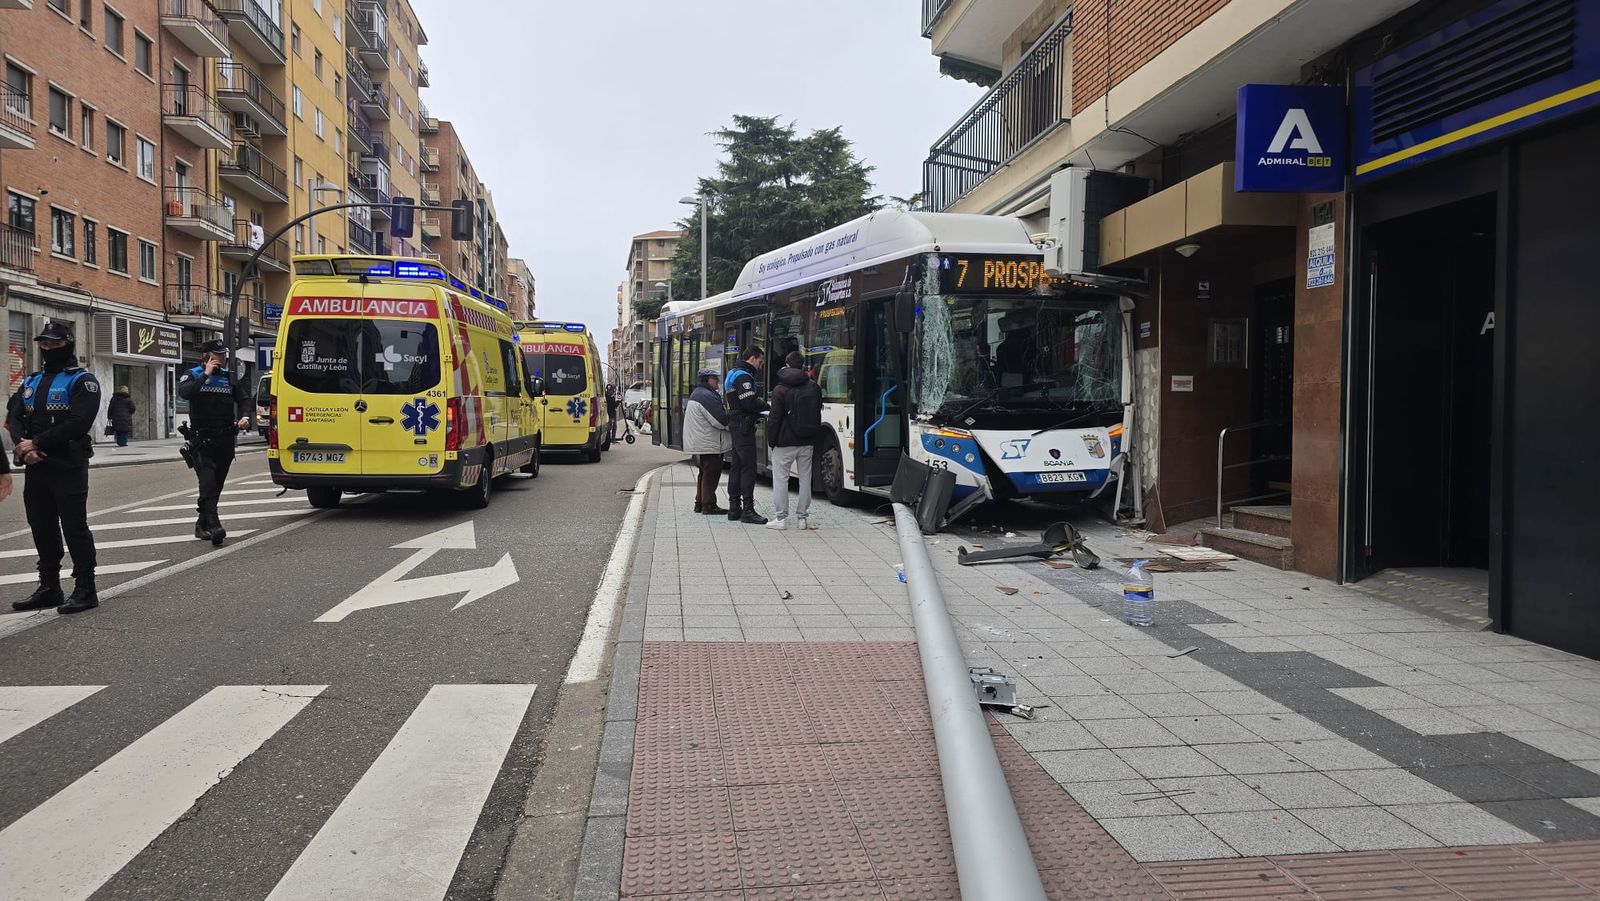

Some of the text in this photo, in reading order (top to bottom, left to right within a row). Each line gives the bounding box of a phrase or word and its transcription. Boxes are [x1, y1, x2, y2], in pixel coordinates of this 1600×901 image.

[1267, 108, 1323, 153] A
[1258, 157, 1331, 167] ADMIRAL BET
[788, 247, 813, 264] Propulsado
[814, 245, 824, 255] con
[825, 240, 835, 254] gas
[836, 229, 859, 247] natural
[1309, 255, 1334, 268] ALQUILA
[957, 260, 969, 288] 7
[298, 299, 428, 316] AMBULANCIA
[404, 354, 427, 364] Sacyl
[297, 363, 347, 372] Castilla y León
[300, 453, 345, 462] 6743 MGZ
[1041, 473, 1085, 482] 8823 KGW
